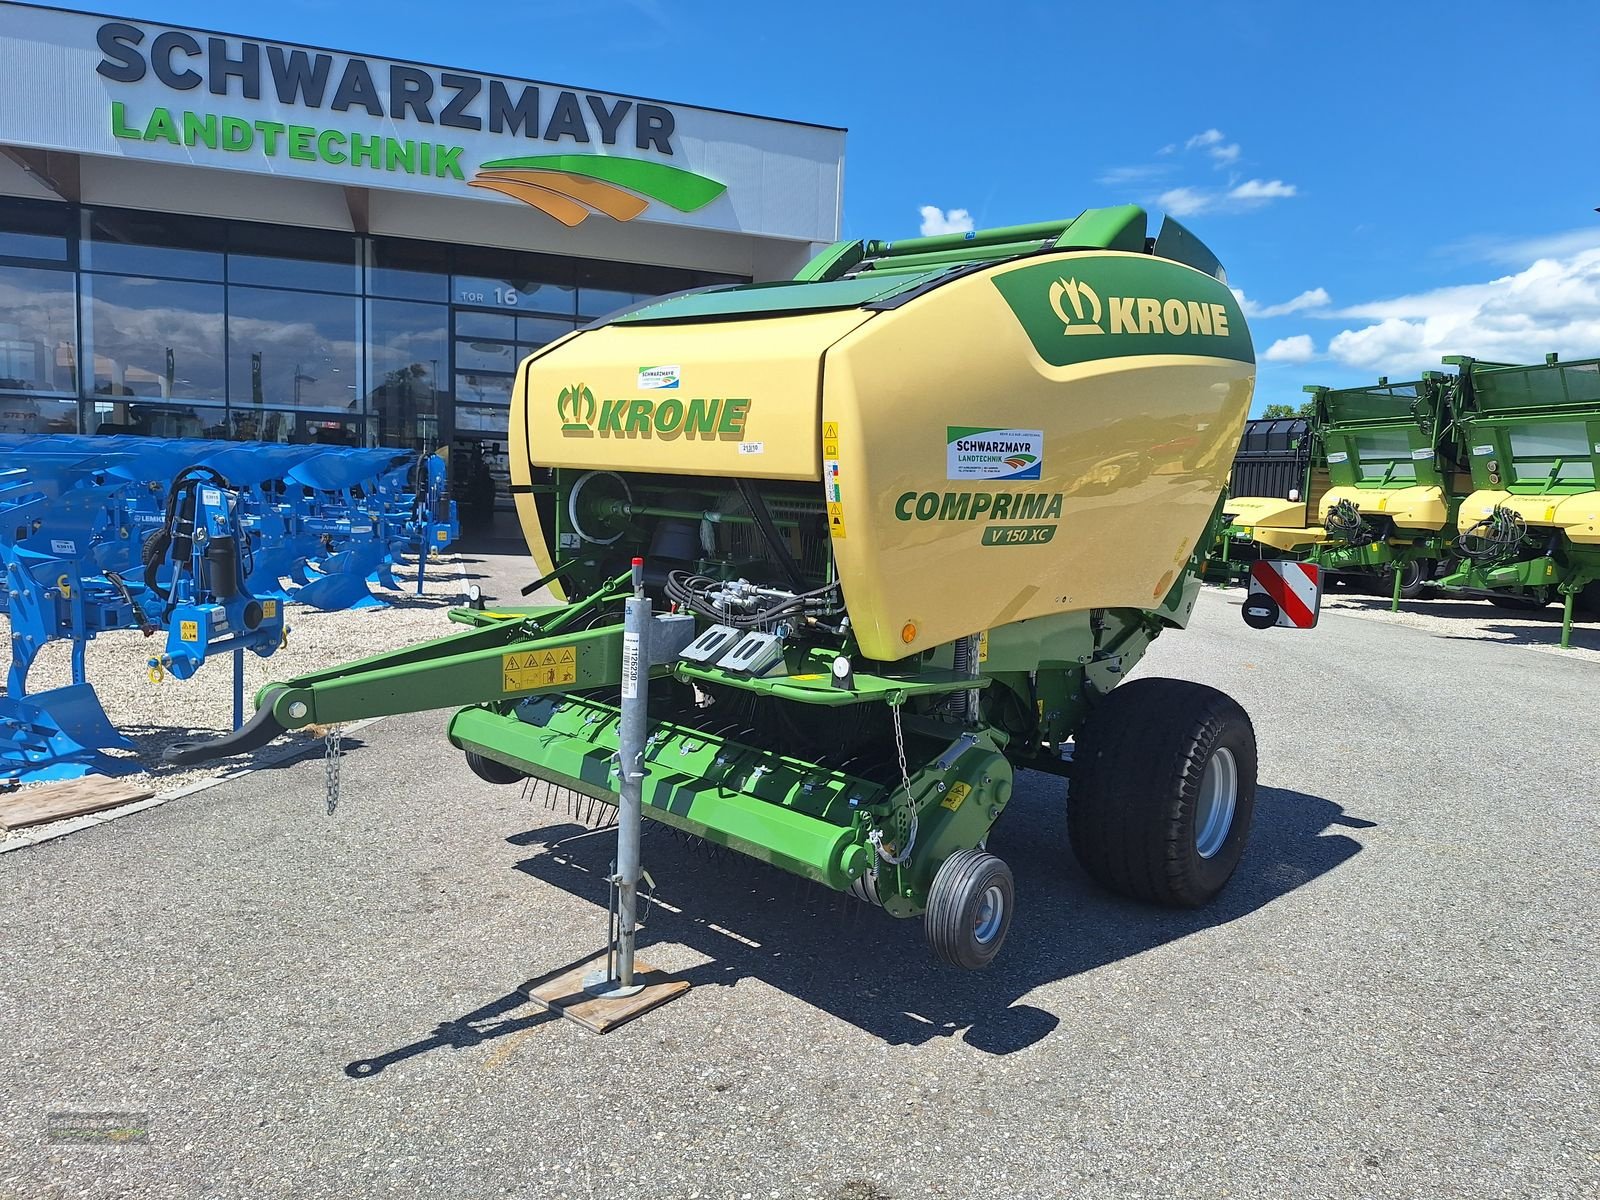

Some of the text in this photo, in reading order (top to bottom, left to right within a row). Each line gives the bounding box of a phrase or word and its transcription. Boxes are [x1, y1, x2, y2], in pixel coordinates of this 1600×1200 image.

[96, 22, 676, 156] SCHWARZMAYR
[111, 101, 466, 180] LANDTECHNIK
[461, 287, 518, 305] TOR 16
[1108, 297, 1230, 336] KRONE
[597, 398, 751, 442] KRONE
[957, 440, 1031, 453] SCHWARZMAYR
[958, 455, 1002, 463] LANDTECHNIK
[894, 491, 1064, 521] COMPRIMA
[992, 529, 1048, 542] V 150 XC
[630, 647, 638, 681] 1126230
